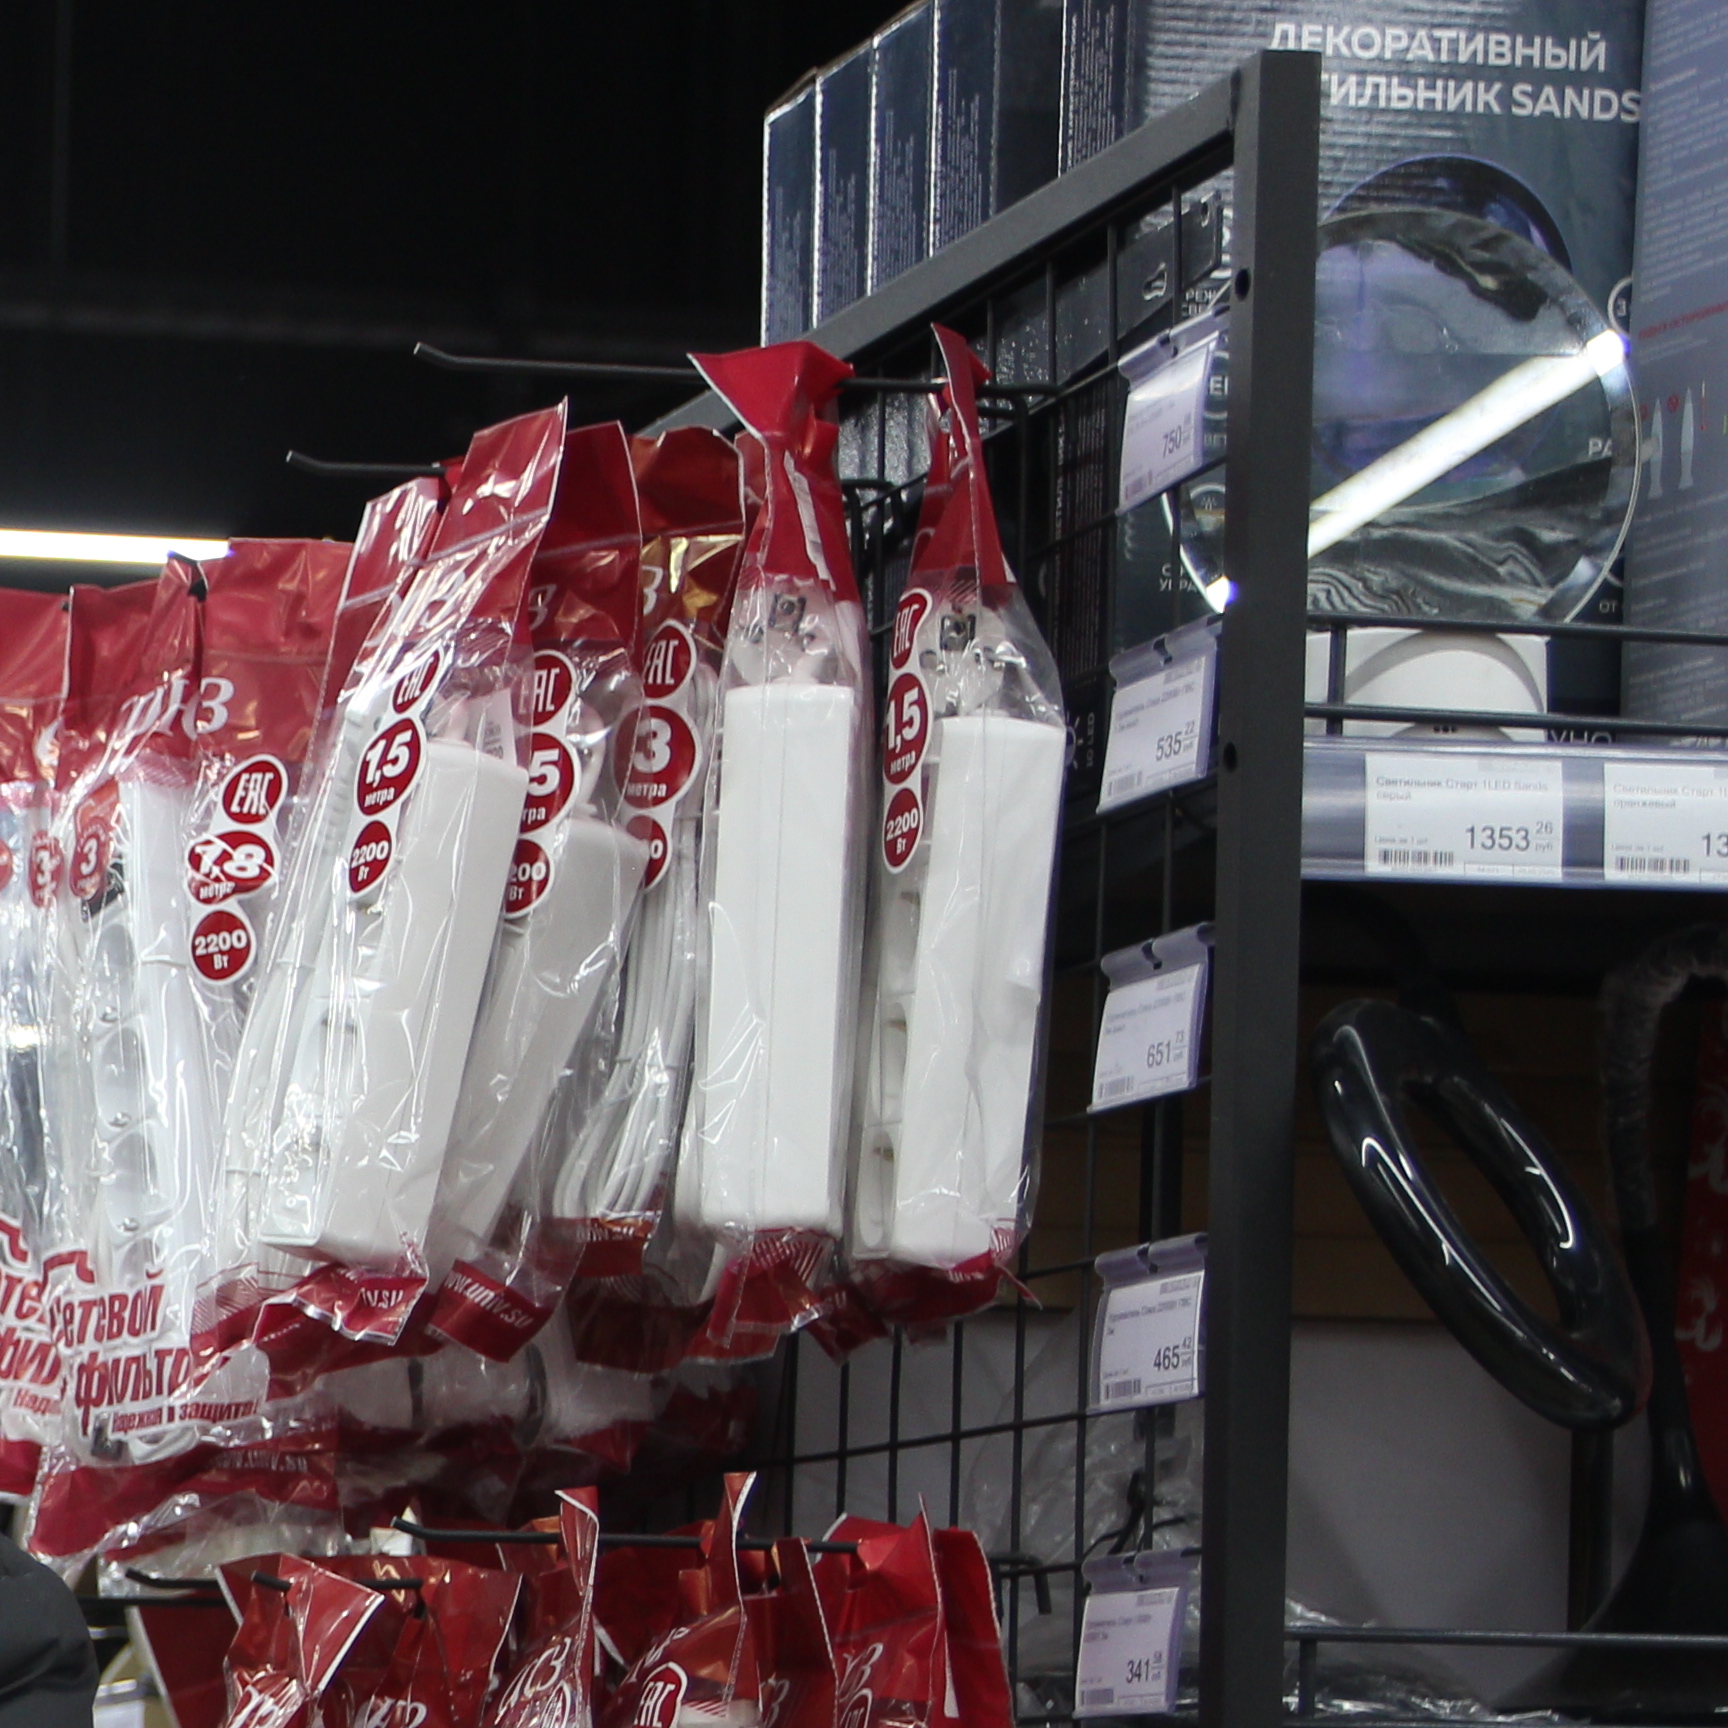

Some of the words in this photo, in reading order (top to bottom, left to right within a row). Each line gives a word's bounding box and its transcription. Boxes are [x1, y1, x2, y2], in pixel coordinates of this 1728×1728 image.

[1271, 21, 1607, 73] ДЕКОРАТИВНЫЙ
[1321, 71, 1503, 116] ИЛЬНИК
[1510, 82, 1641, 124] SANDS
[1161, 424, 1183, 459] 750
[885, 686, 921, 754] 1,5
[365, 728, 413, 788] 1,5
[634, 718, 672, 774] 3
[1155, 730, 1183, 762] 535
[363, 785, 395, 808] метра
[885, 806, 919, 842] 2200
[1464, 824, 1531, 853] 1353
[1534, 820, 1554, 836] 26
[80, 837, 98, 872] 3
[351, 839, 389, 869] 2200
[896, 836, 907, 856] Вт
[357, 862, 371, 882] Вт
[194, 928, 247, 956] 2200
[212, 951, 231, 971] Вт
[1146, 1040, 1172, 1069] 651
[1153, 1345, 1181, 1372] 465
[1126, 1658, 1150, 1684] 341
